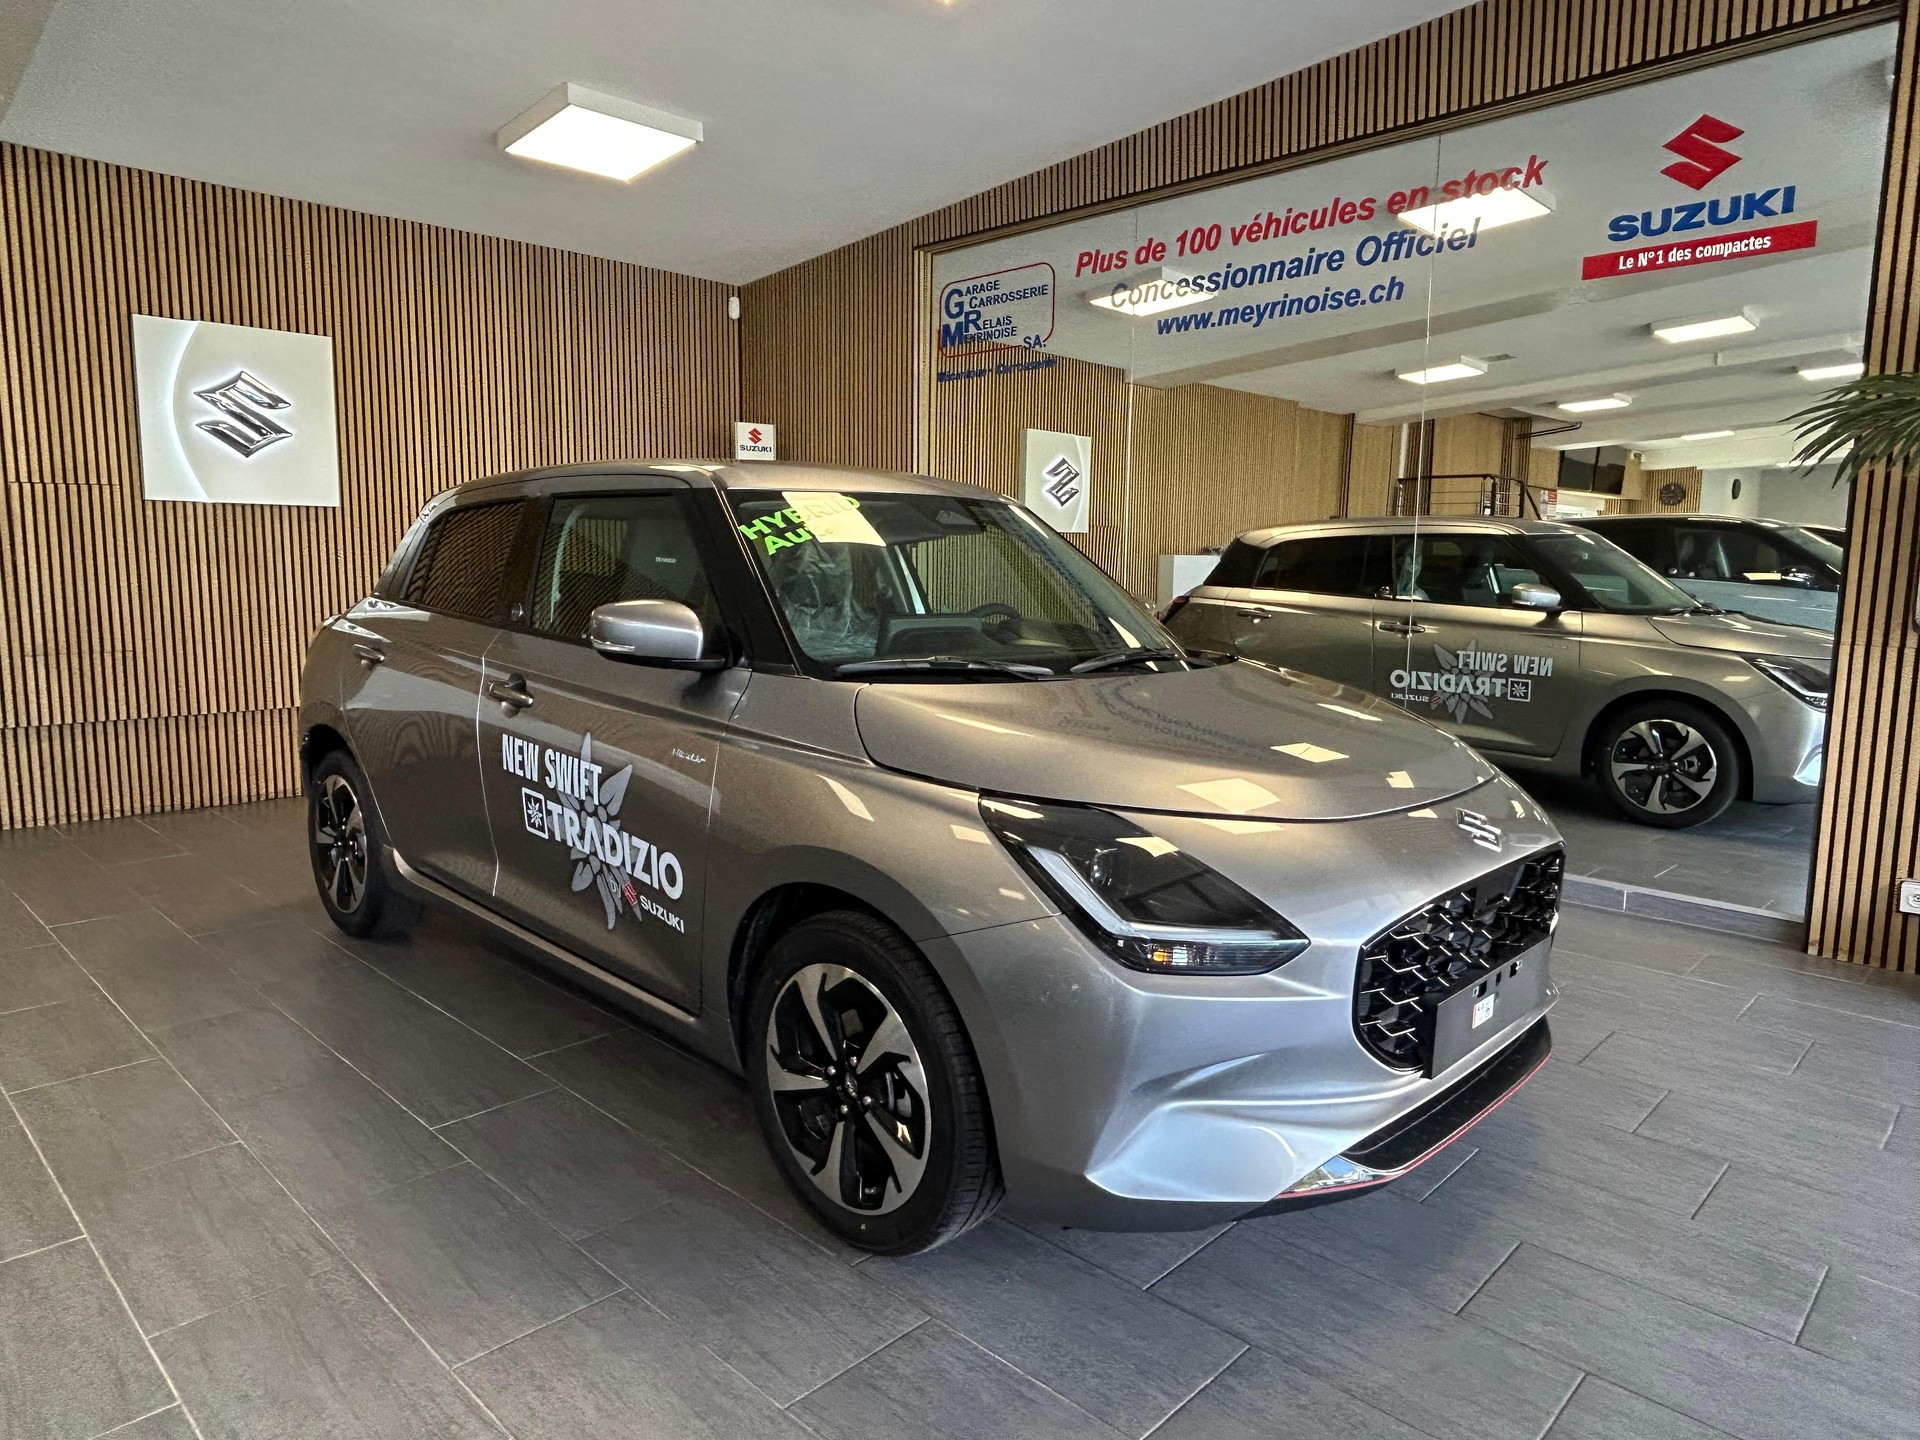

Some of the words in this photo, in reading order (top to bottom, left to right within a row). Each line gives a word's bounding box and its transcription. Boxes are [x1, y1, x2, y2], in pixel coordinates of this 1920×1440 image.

[1075, 249, 1128, 278] Plus
[1134, 237, 1167, 264] de
[1176, 223, 1222, 257] 100
[1230, 197, 1377, 246] véhicules
[1387, 185, 1430, 215] en
[1441, 154, 1549, 203] stock
[1607, 185, 1796, 242] SUZUKI
[1111, 248, 1345, 308] Concessionnaire
[1356, 216, 1482, 267] Officiel
[1618, 255, 1634, 270] Le
[1668, 245, 1692, 262] des
[1695, 234, 1772, 259] compactes
[963, 309, 1013, 334] RELAIS
[969, 284, 1049, 309] CARROSSERIE
[1157, 275, 1405, 336] www.meyrinoise.ch
[740, 444, 772, 453] SUZUKI
[502, 733, 539, 783] NEW
[544, 748, 602, 805] SWIFT
[546, 800, 684, 900] TRADIZIO
[639, 895, 685, 934] SUZUKI
